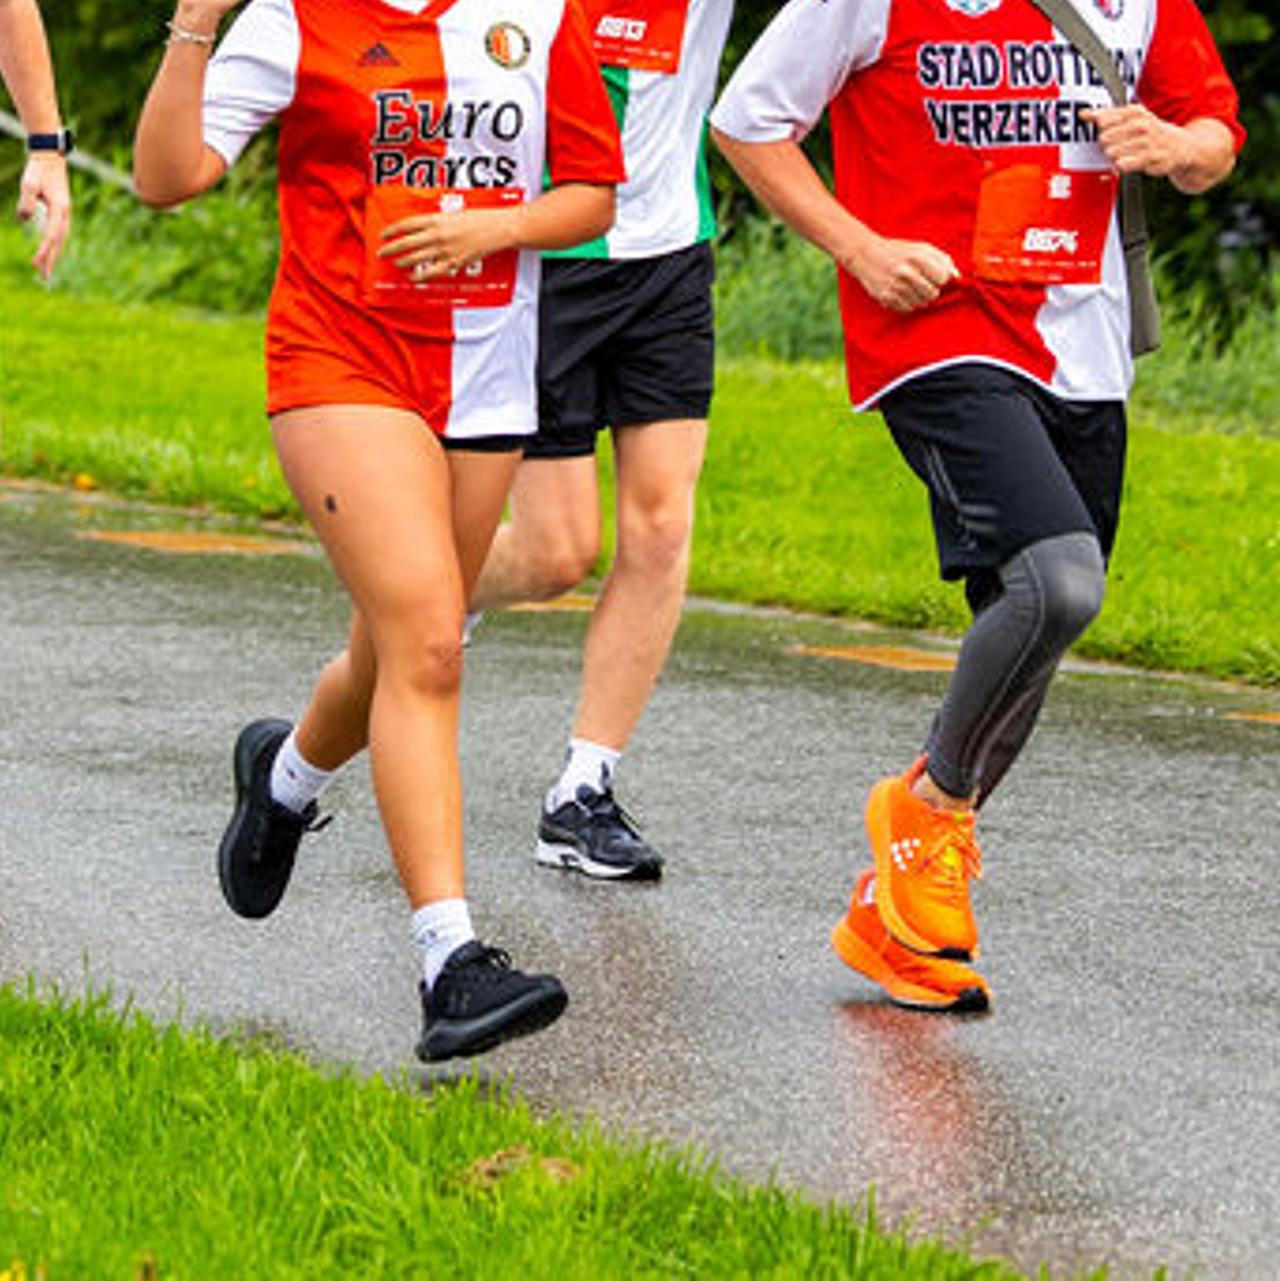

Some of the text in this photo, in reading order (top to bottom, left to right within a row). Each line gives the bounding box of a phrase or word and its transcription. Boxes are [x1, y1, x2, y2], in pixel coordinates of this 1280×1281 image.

[918, 42, 1002, 90] STAD
[371, 90, 524, 145] Euro
[371, 149, 518, 188] Parcs
